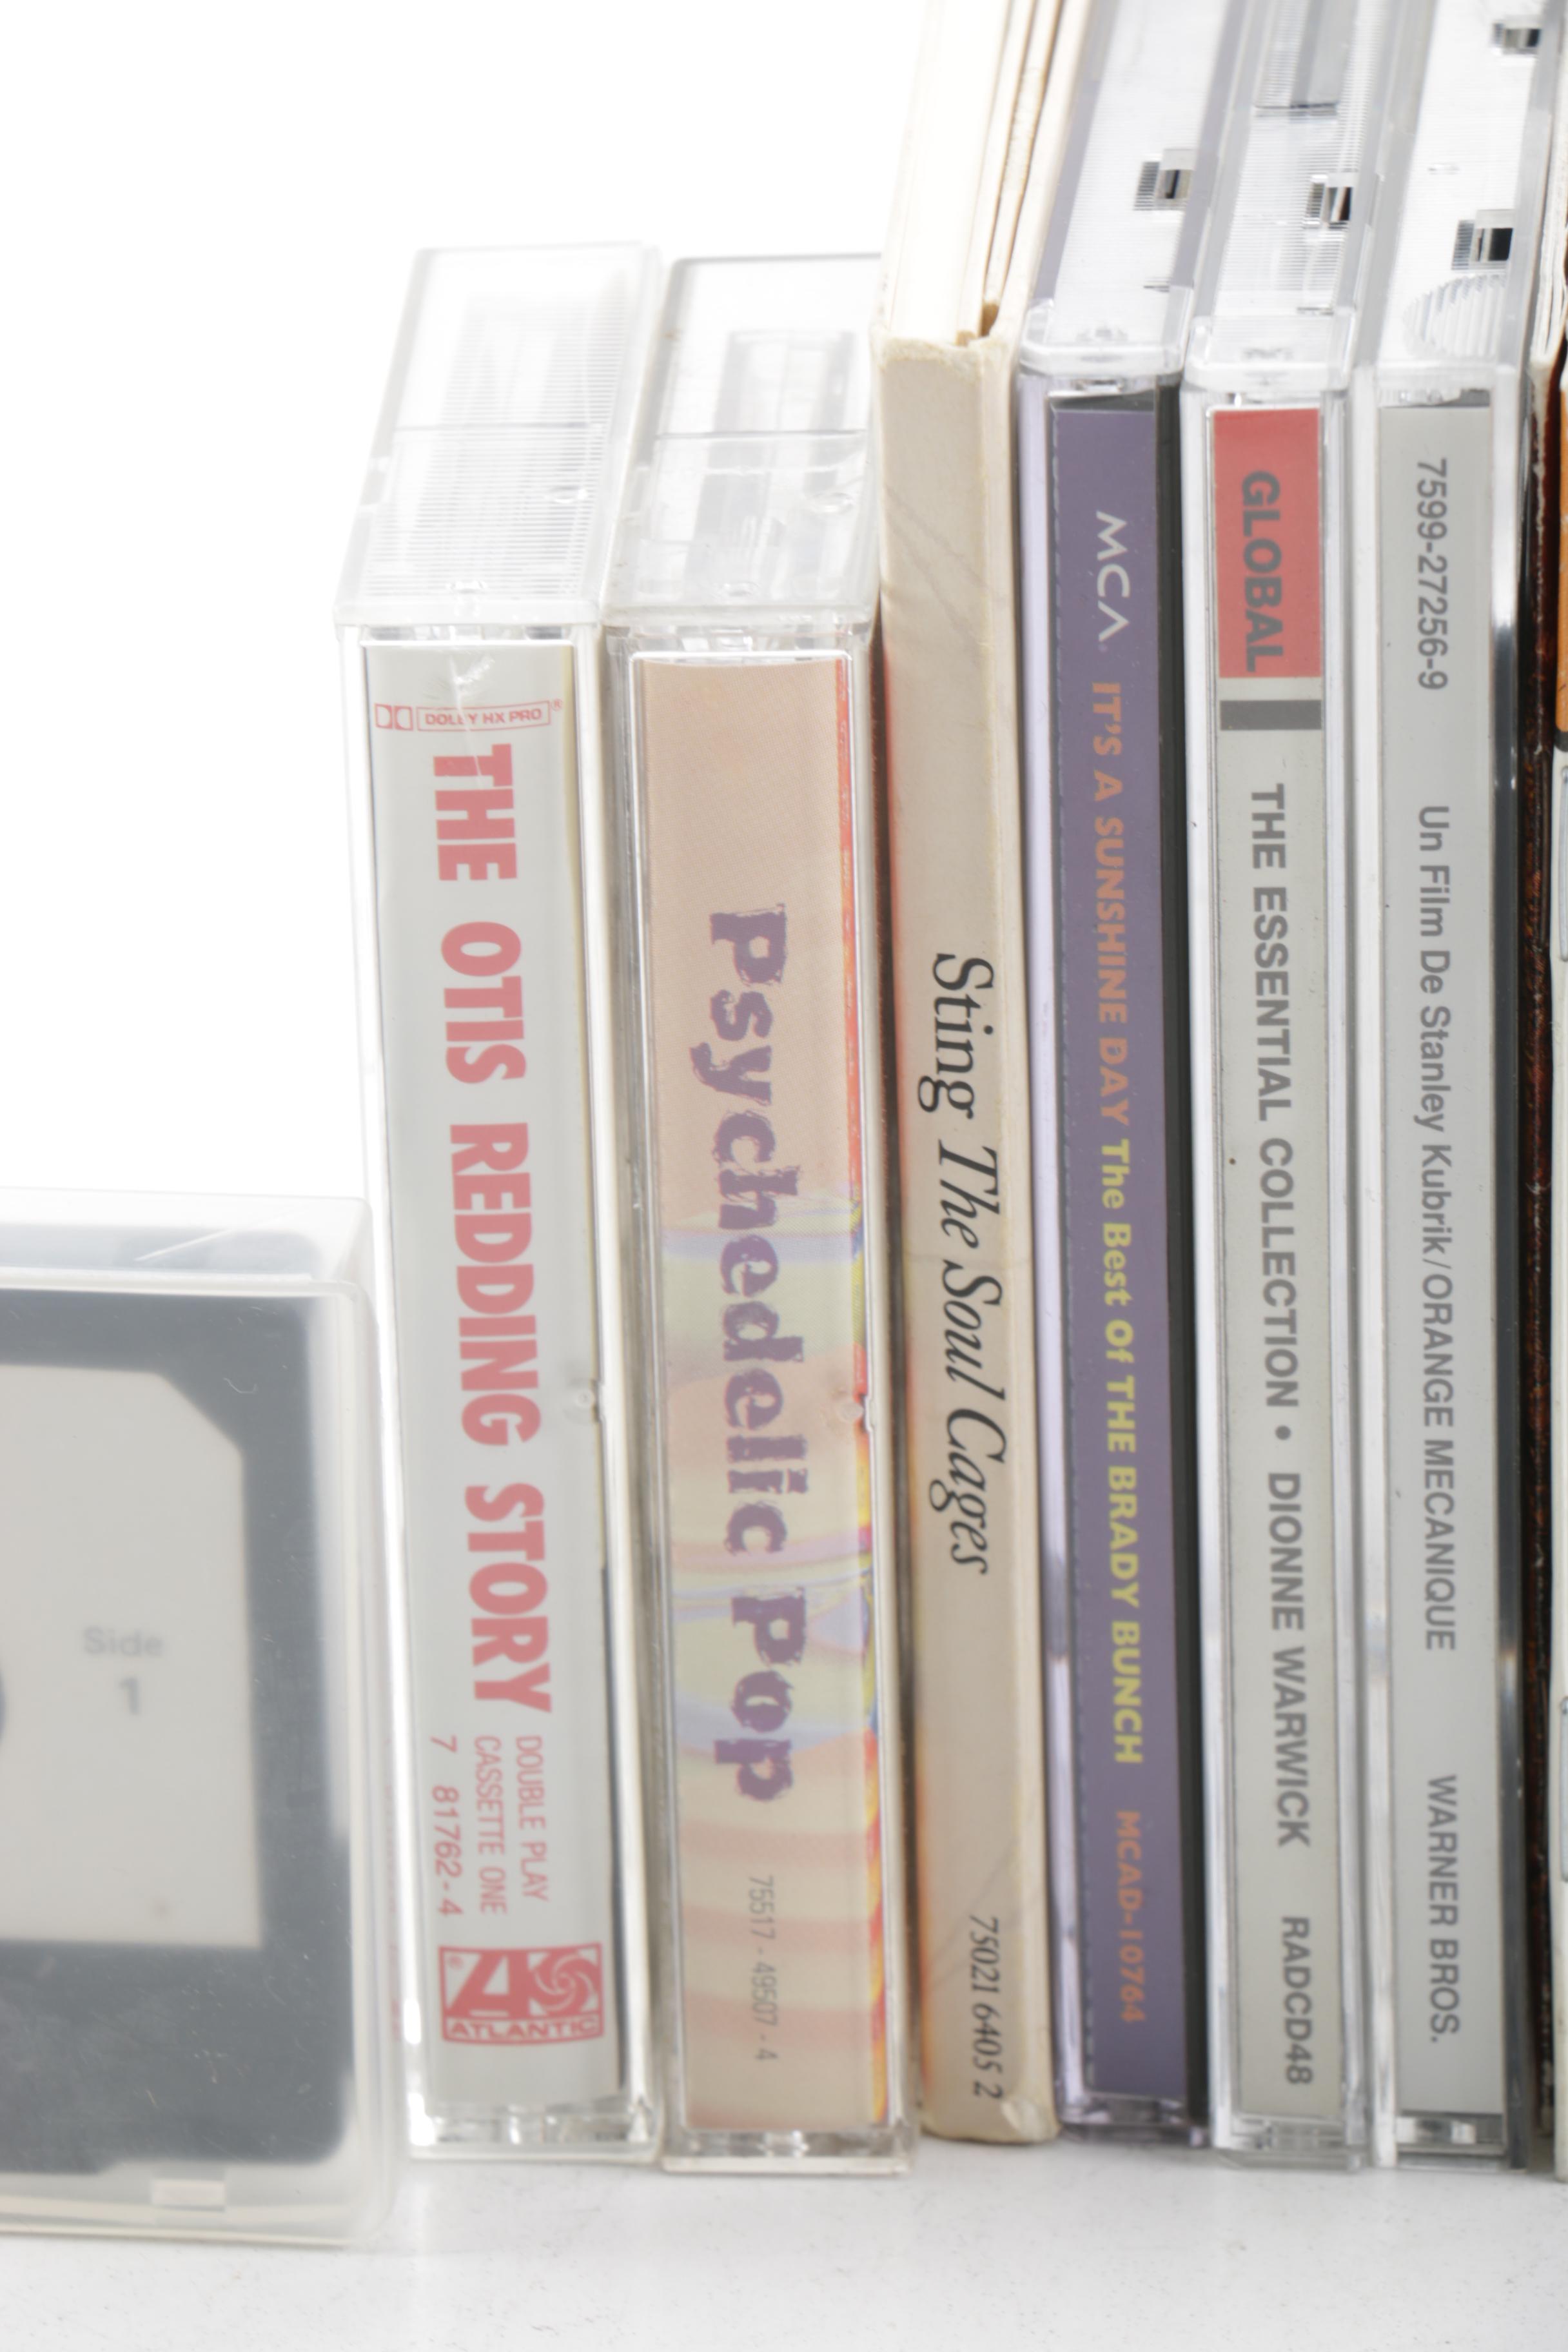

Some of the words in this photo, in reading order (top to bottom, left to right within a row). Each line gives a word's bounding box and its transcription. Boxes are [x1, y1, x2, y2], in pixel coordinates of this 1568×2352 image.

[1097, 511, 1130, 642] MCA
[1242, 471, 1284, 672] GLOBAL
[1417, 458, 1448, 689] 7599-27256-9
[483, 712, 505, 723] HX
[509, 709, 542, 721] PRO
[1093, 683, 1122, 755] IT'S
[433, 743, 516, 881] THE
[1094, 770, 1122, 801] A
[1251, 783, 1286, 868] THE
[1418, 806, 1449, 851] Un
[1095, 817, 1127, 1023] SUNSHINE
[1420, 865, 1450, 936] Film
[441, 922, 526, 1084] OTIS
[1253, 887, 1291, 1121] ESSENTIAL
[1420, 950, 1450, 994] De
[917, 953, 994, 1119] Sting
[1099, 1037, 1128, 1125] DAY
[1413, 1006, 1451, 1132] Stanley
[691, 904, 807, 1555] Psychedelic
[939, 1139, 1000, 1249] The
[1102, 1139, 1130, 1209] The
[451, 1123, 542, 1446] REDDING
[1104, 1222, 1132, 1306] Best
[1260, 1138, 1298, 1406] COLLECTION
[942, 1259, 1006, 1401] Soul
[1106, 1320, 1133, 1363] Of
[1107, 1375, 1135, 1452] THE
[928, 1408, 1006, 1574] Cages
[1108, 1465, 1139, 1607] BRADY
[1424, 1440, 1455, 1650] MECANIQUE
[465, 1484, 551, 1712] STORY
[1268, 1473, 1304, 1630] DIONNE
[83, 1626, 164, 1658] Side
[119, 1676, 140, 1715] 1
[713, 1588, 808, 1802] Pop
[1112, 1621, 1142, 1763] BUNCH
[431, 1736, 457, 1753] 7
[474, 1736, 505, 1855] CASSETTE
[516, 1736, 546, 1829] DOUBLE
[1273, 1647, 1310, 1847] WARWICK
[478, 1867, 507, 1914] ONE
[520, 1841, 548, 1901] PLAY
[1429, 1775, 1458, 1926] WARNER
[970, 1916, 1001, 1994] 75021
[1117, 1810, 1146, 2023] MCAD-10764
[449, 2020, 597, 2038] ATLANTIC
[972, 2001, 1003, 2074] 6405
[1283, 1917, 1314, 2085] RADCD48
[1429, 1939, 1460, 2043] BROS.
[973, 2081, 1004, 2101] 2
